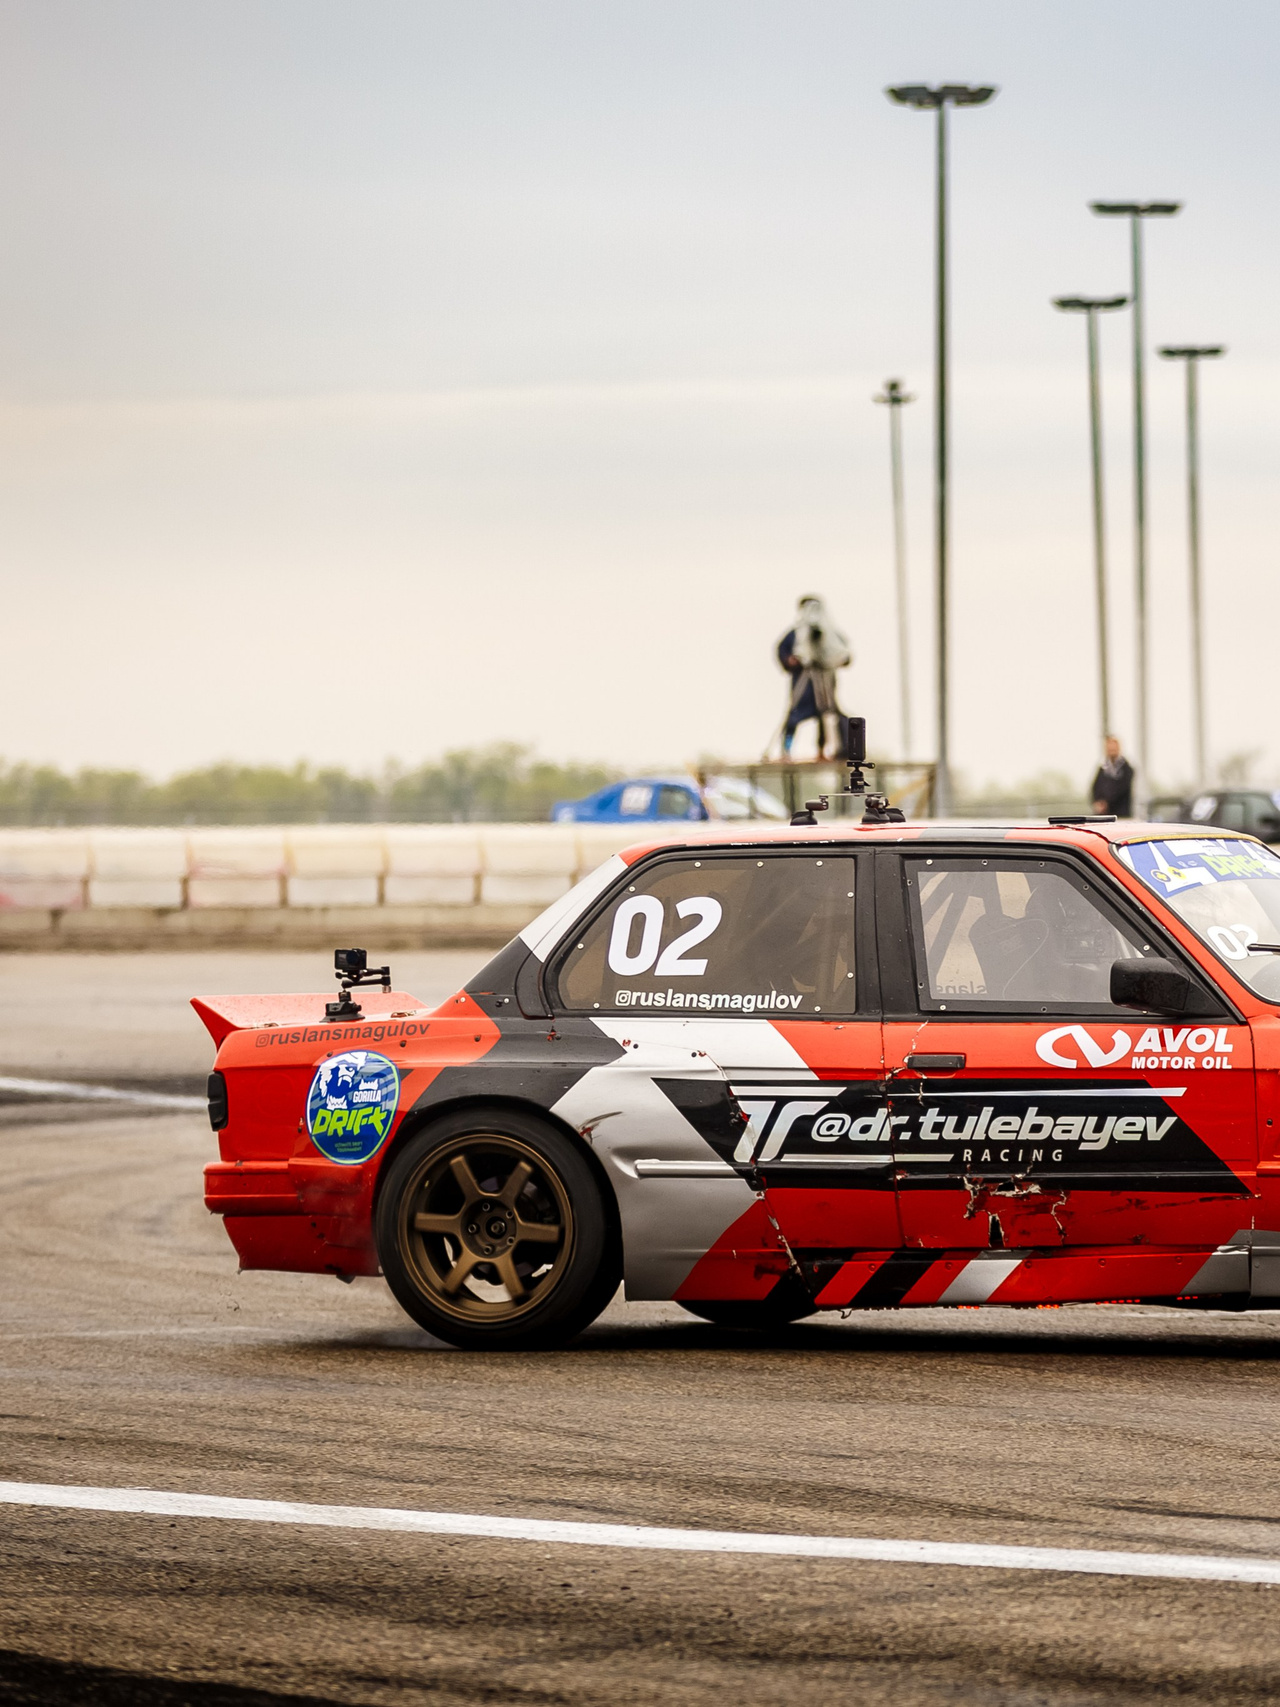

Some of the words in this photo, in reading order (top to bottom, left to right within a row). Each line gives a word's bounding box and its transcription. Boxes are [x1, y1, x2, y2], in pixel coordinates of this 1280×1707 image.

[607, 894, 723, 977] 02
[1207, 923, 1274, 961] 02
[1134, 1027, 1233, 1053] AVOL
[1131, 1056, 1196, 1070] MOTOR
[1201, 1056, 1233, 1070] OIL
[352, 1089, 382, 1103] GORILLA
[311, 1105, 388, 1138] DRIFT
[810, 1106, 1178, 1150] @dr.tulebayev
[962, 1148, 1063, 1162] RACING
